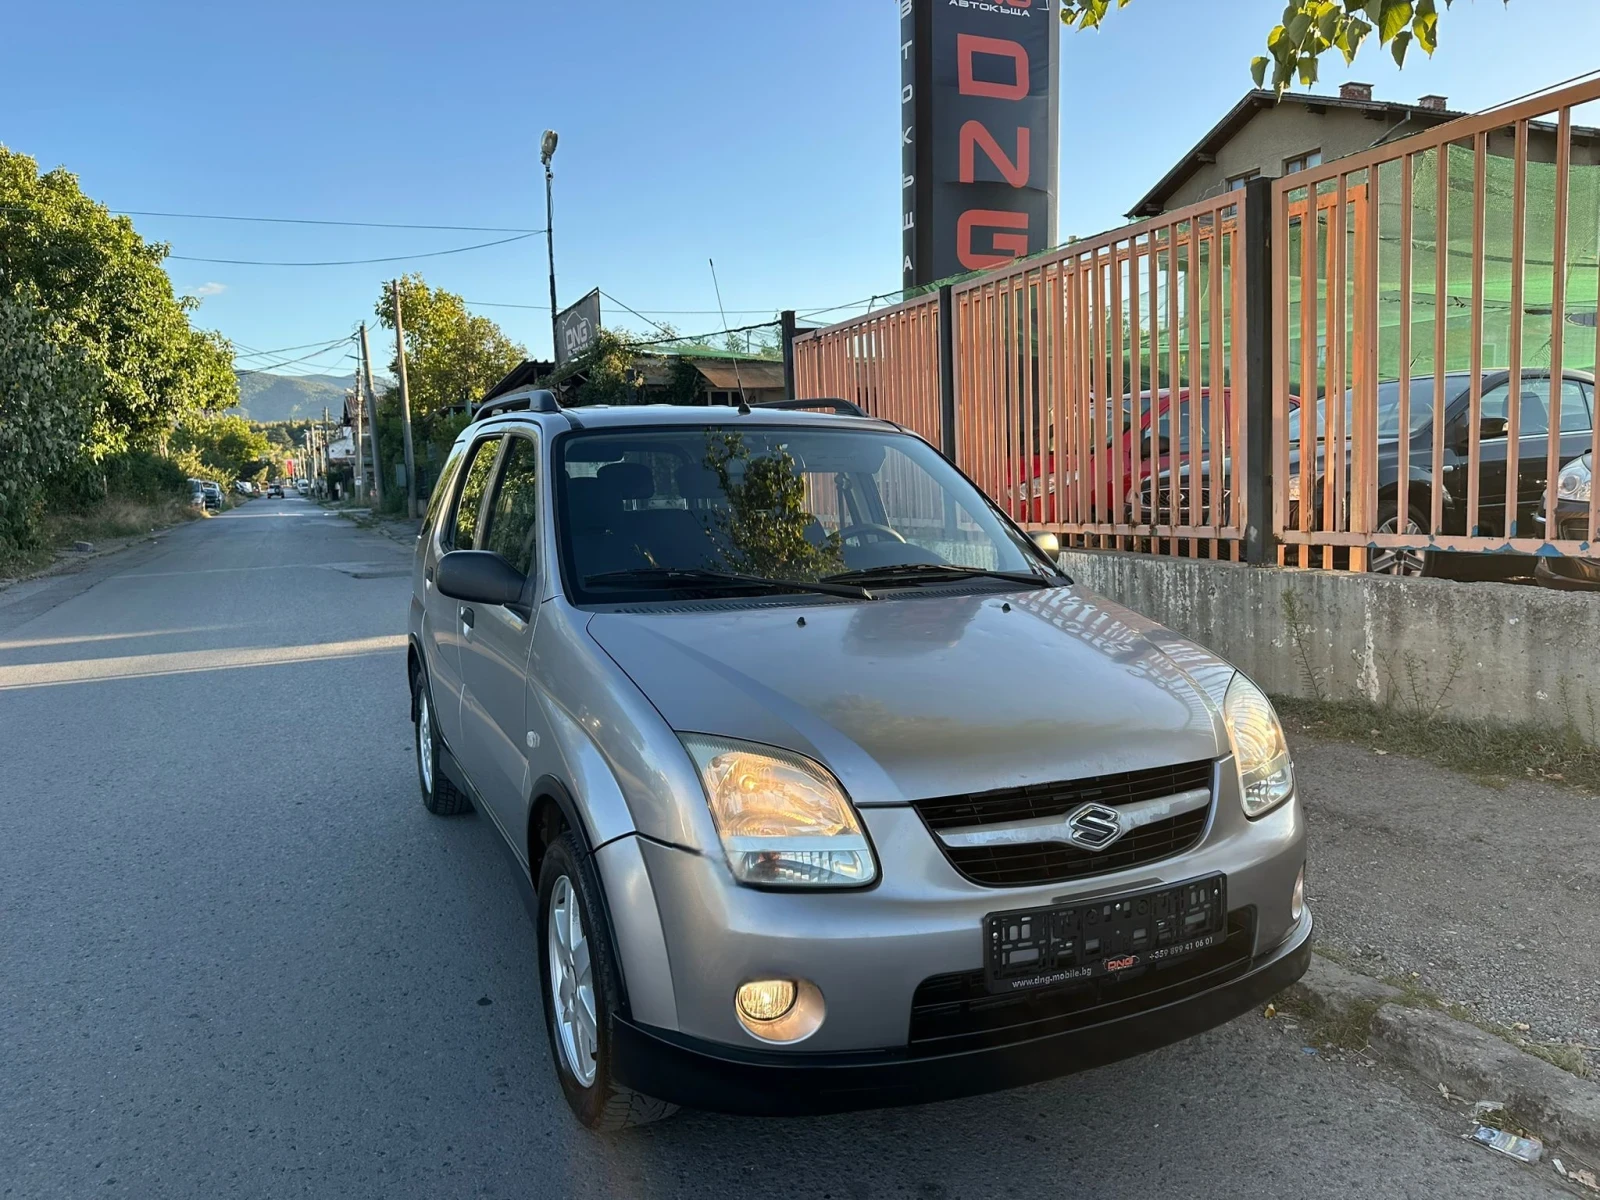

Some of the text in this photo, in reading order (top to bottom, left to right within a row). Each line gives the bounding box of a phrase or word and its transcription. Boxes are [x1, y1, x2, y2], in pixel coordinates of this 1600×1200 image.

[957, 33, 1029, 270] DNG
[566, 320, 587, 350] DNG
[1149, 949, 1169, 960] +359
[1185, 942, 1193, 950] 41
[1195, 939, 1204, 948] 06
[1205, 936, 1213, 945] 01
[1107, 956, 1133, 970] DNG
[1012, 967, 1092, 988] www.dng.mobile.bg
